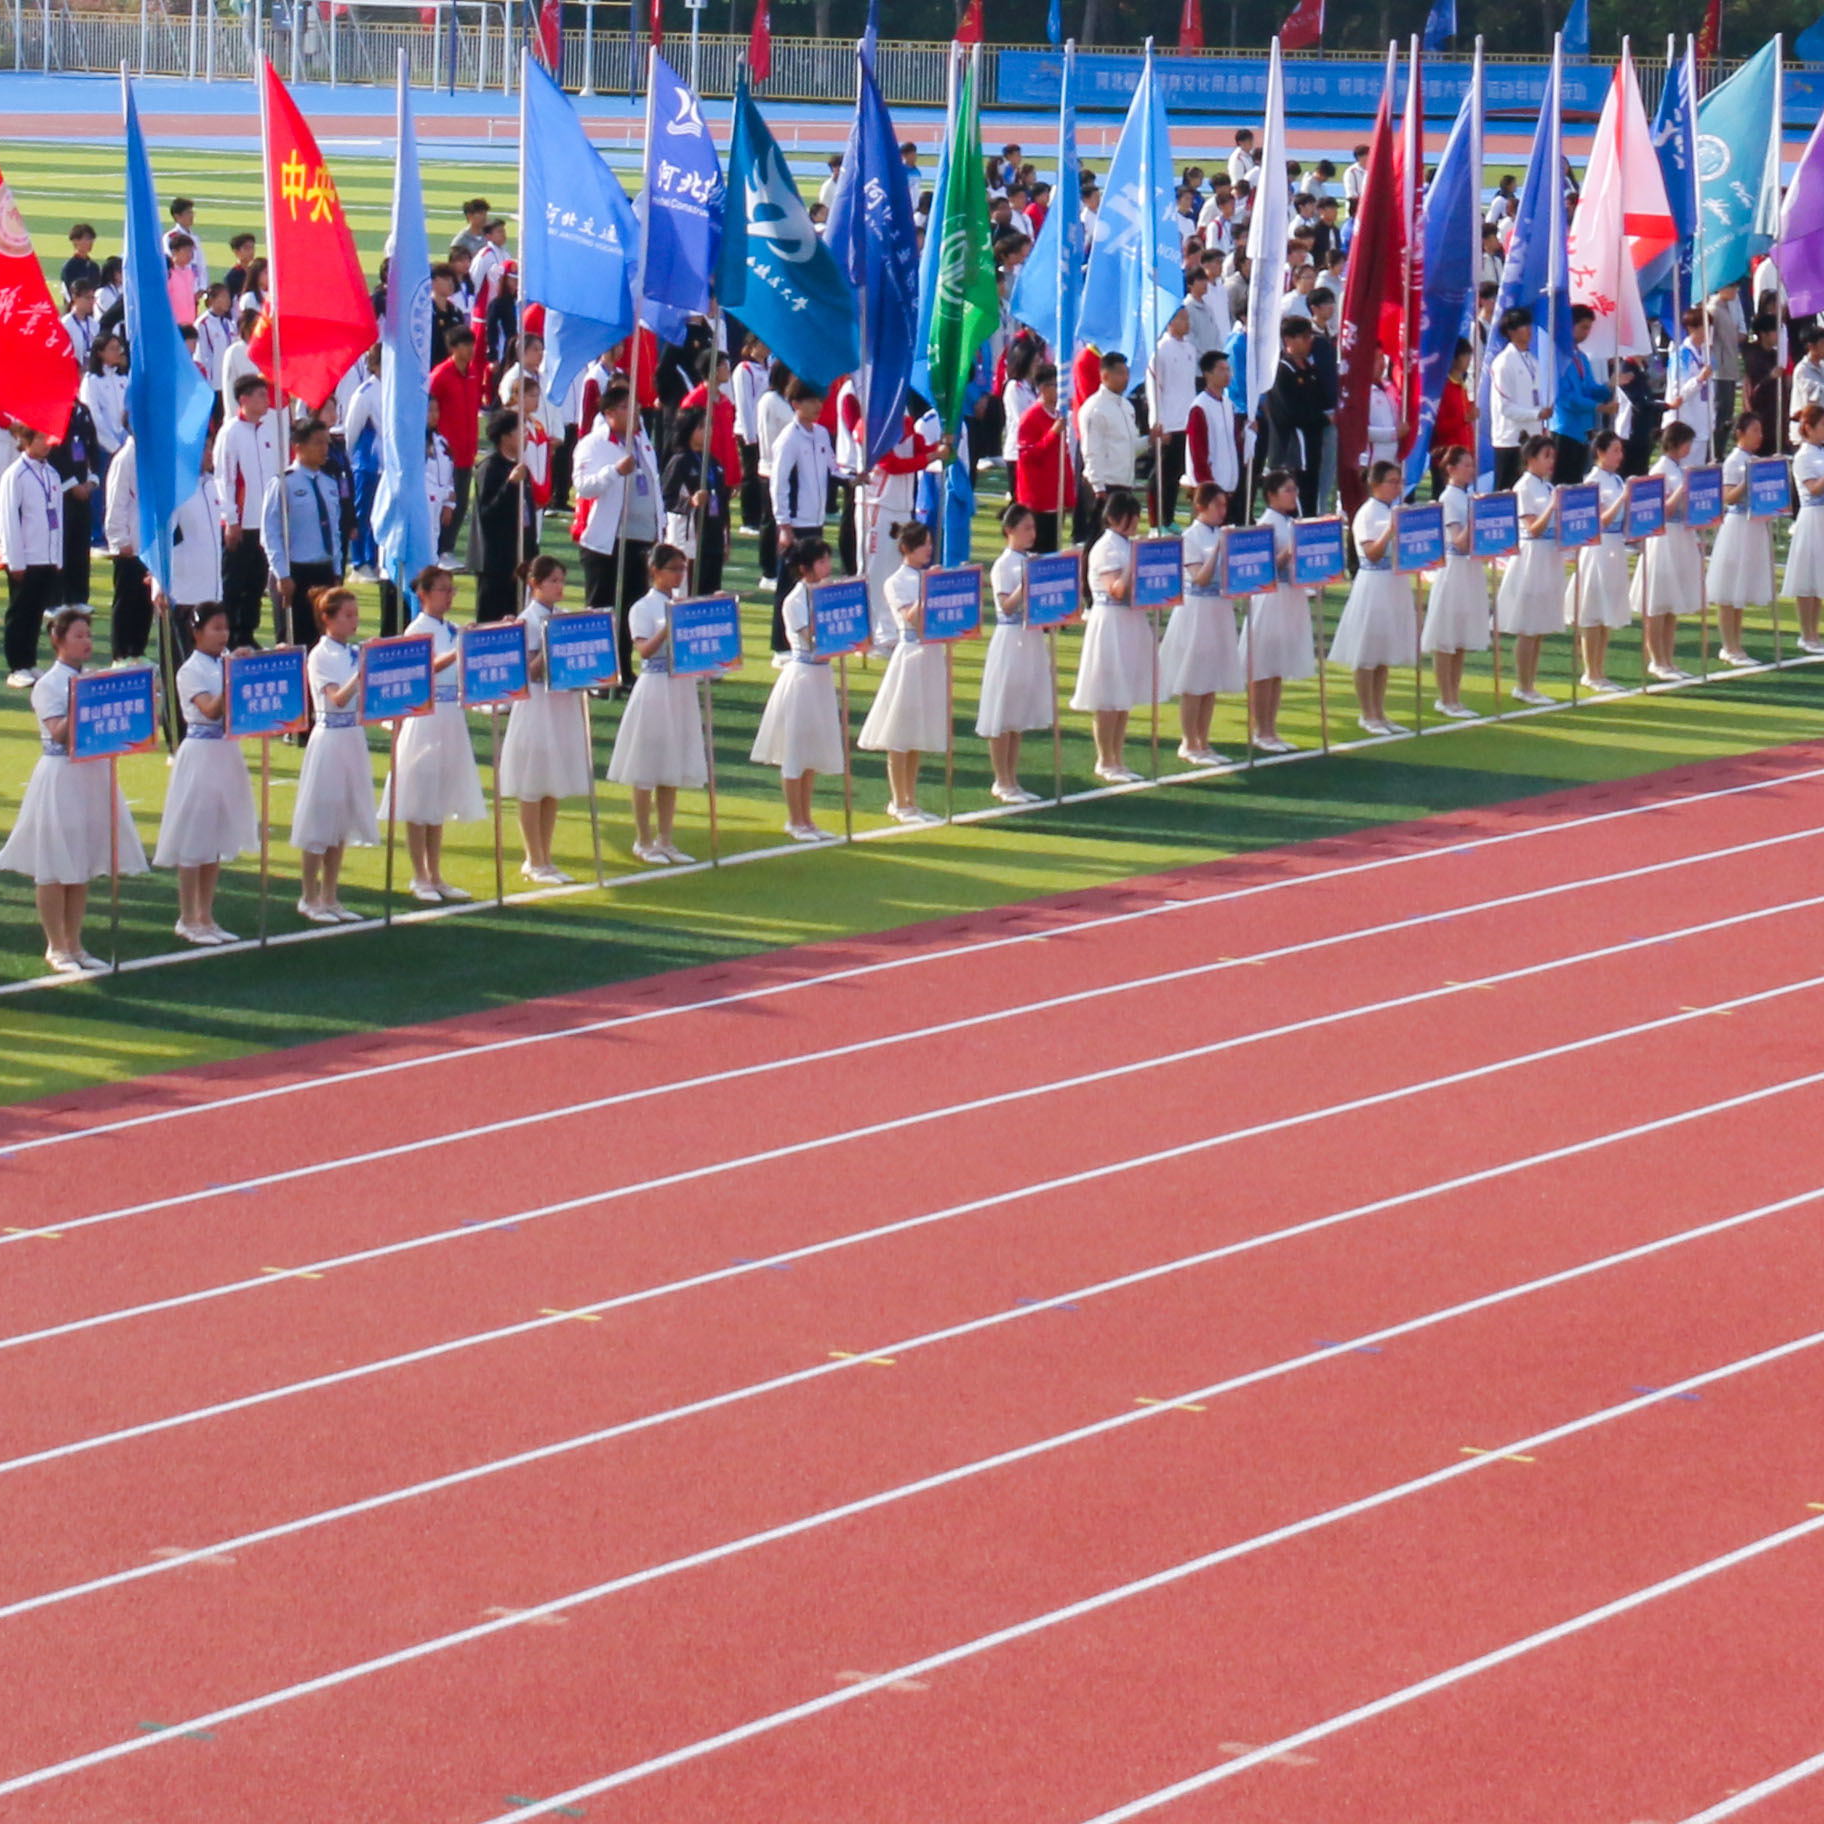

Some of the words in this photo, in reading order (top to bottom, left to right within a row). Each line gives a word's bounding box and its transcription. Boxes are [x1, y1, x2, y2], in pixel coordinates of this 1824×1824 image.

[241, 679, 289, 700] 保定学院
[79, 698, 145, 723] 唐山师范学院
[247, 696, 283, 714] 代表队
[93, 716, 131, 735] 代表队
